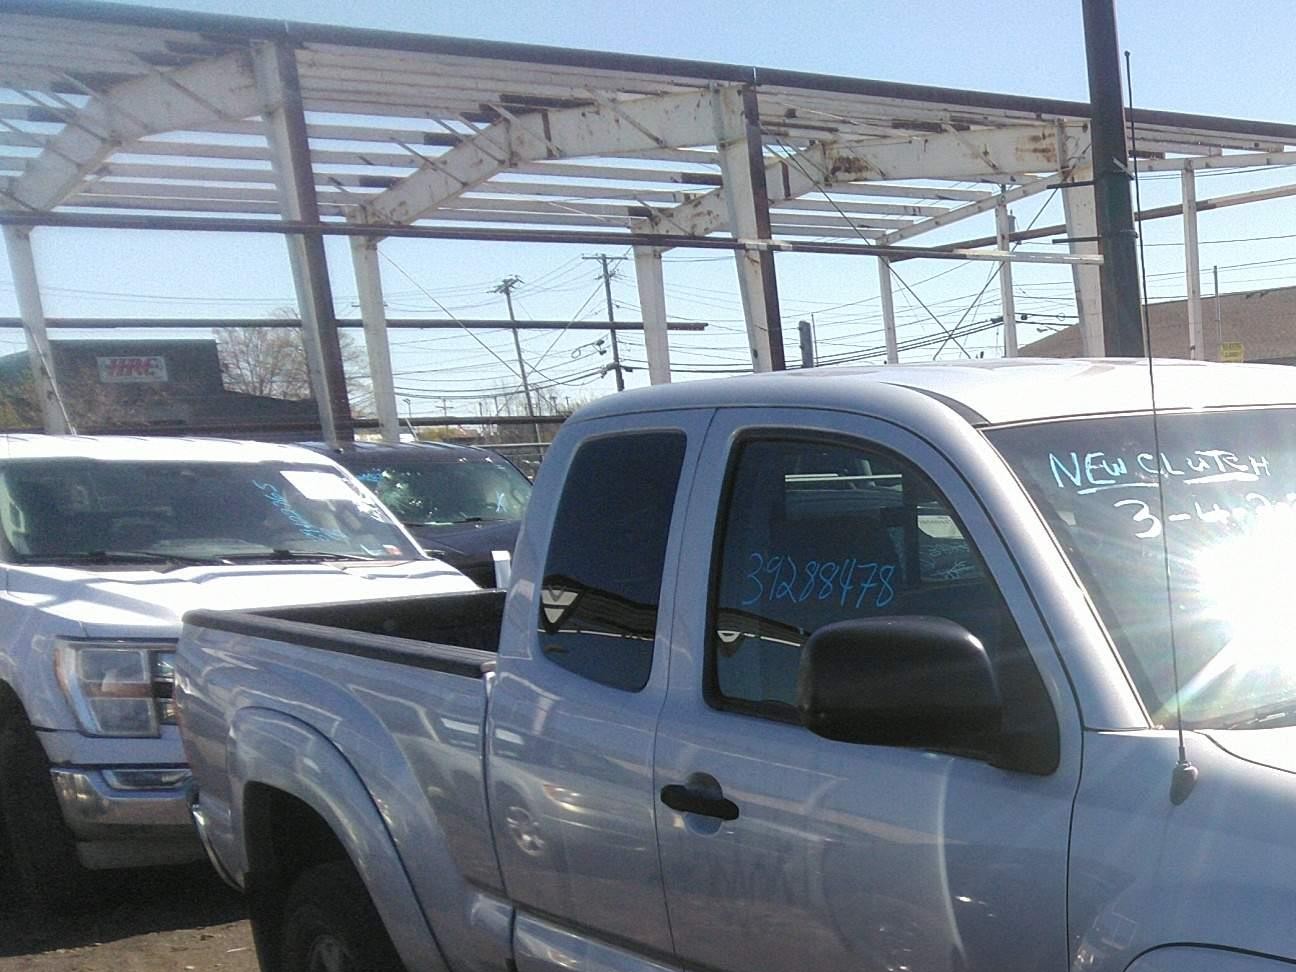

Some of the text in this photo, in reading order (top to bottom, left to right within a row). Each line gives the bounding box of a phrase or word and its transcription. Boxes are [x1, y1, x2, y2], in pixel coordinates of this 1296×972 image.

[1049, 449, 1271, 488] NEW CLUTCH
[741, 552, 896, 609] 39288478
